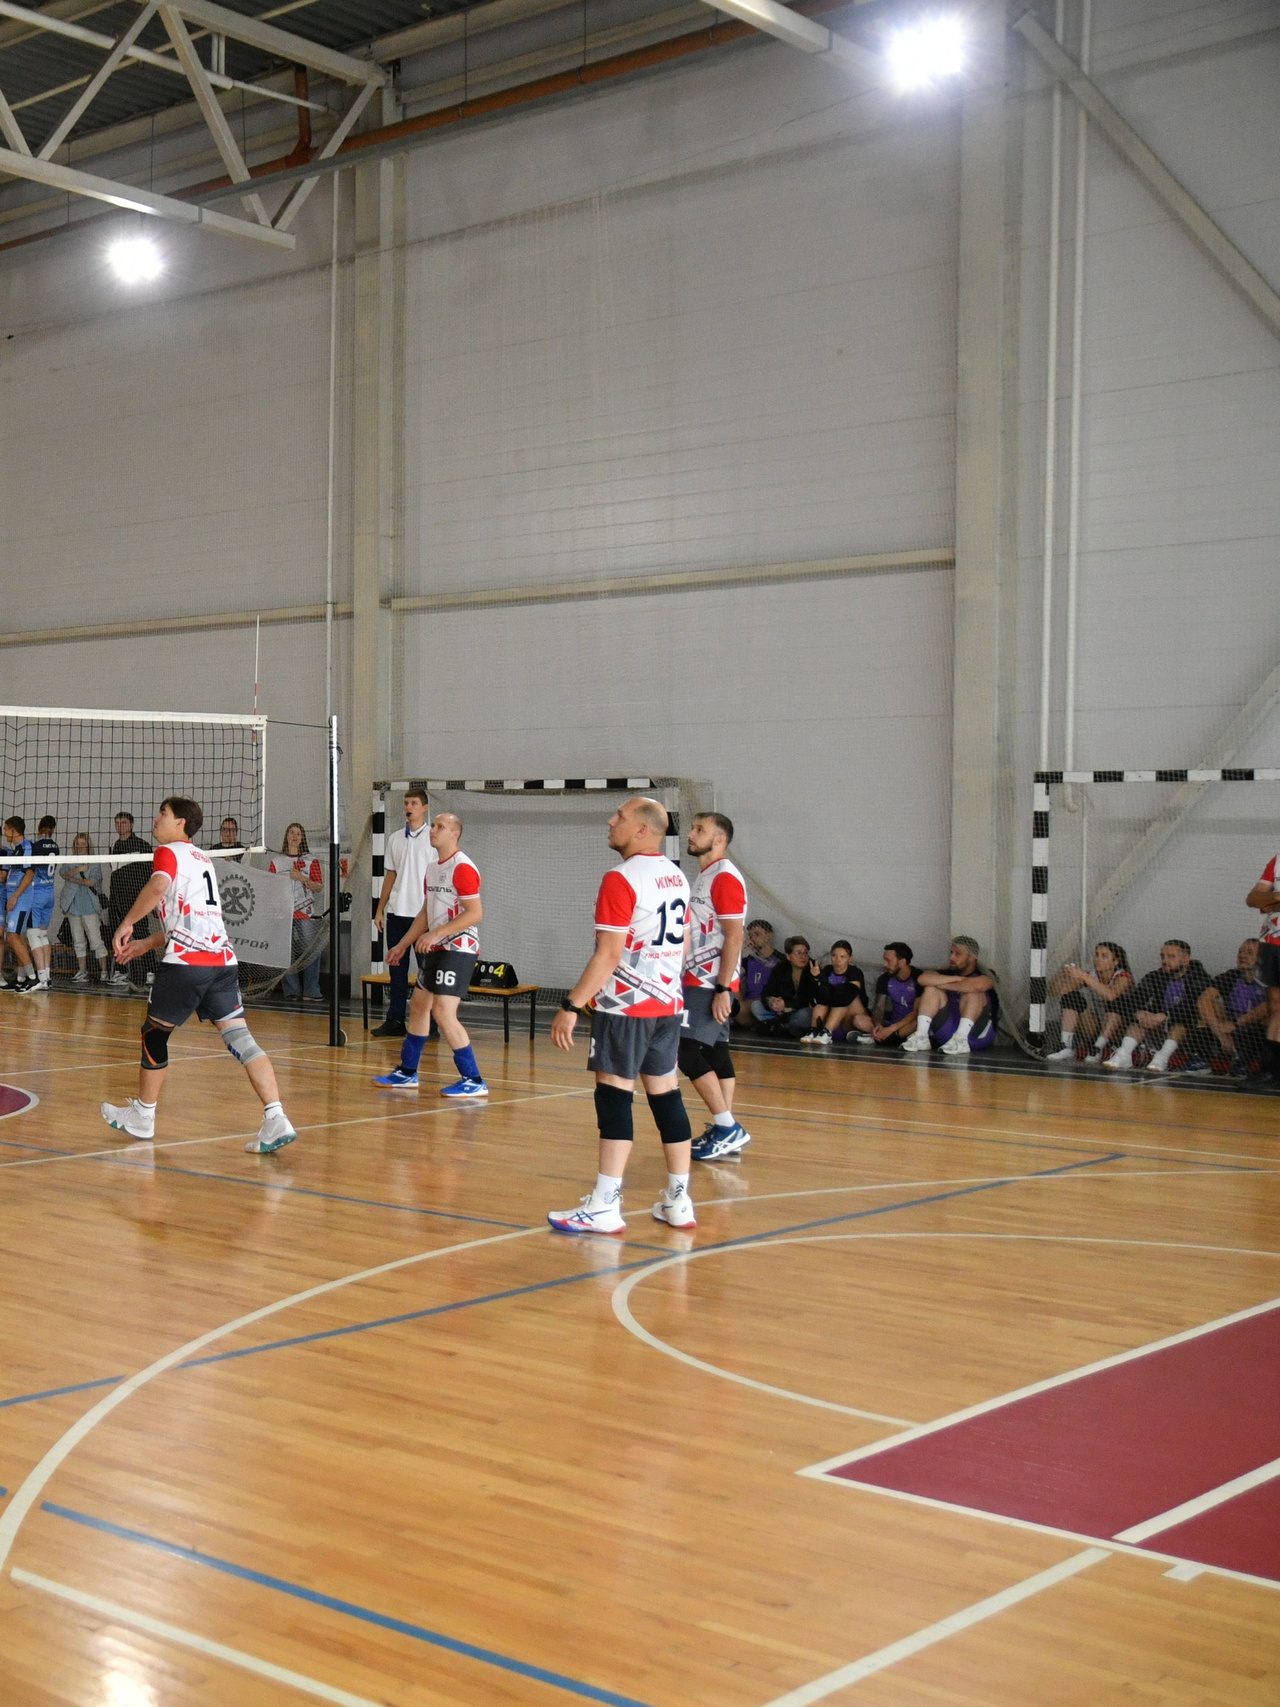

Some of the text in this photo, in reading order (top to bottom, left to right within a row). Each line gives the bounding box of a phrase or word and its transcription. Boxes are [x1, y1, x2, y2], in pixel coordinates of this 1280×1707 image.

[202, 870, 218, 906] 1
[651, 898, 686, 946] 13
[228, 935, 269, 950] ТРОЙ
[435, 970, 457, 986] 96
[493, 963, 505, 978] 4
